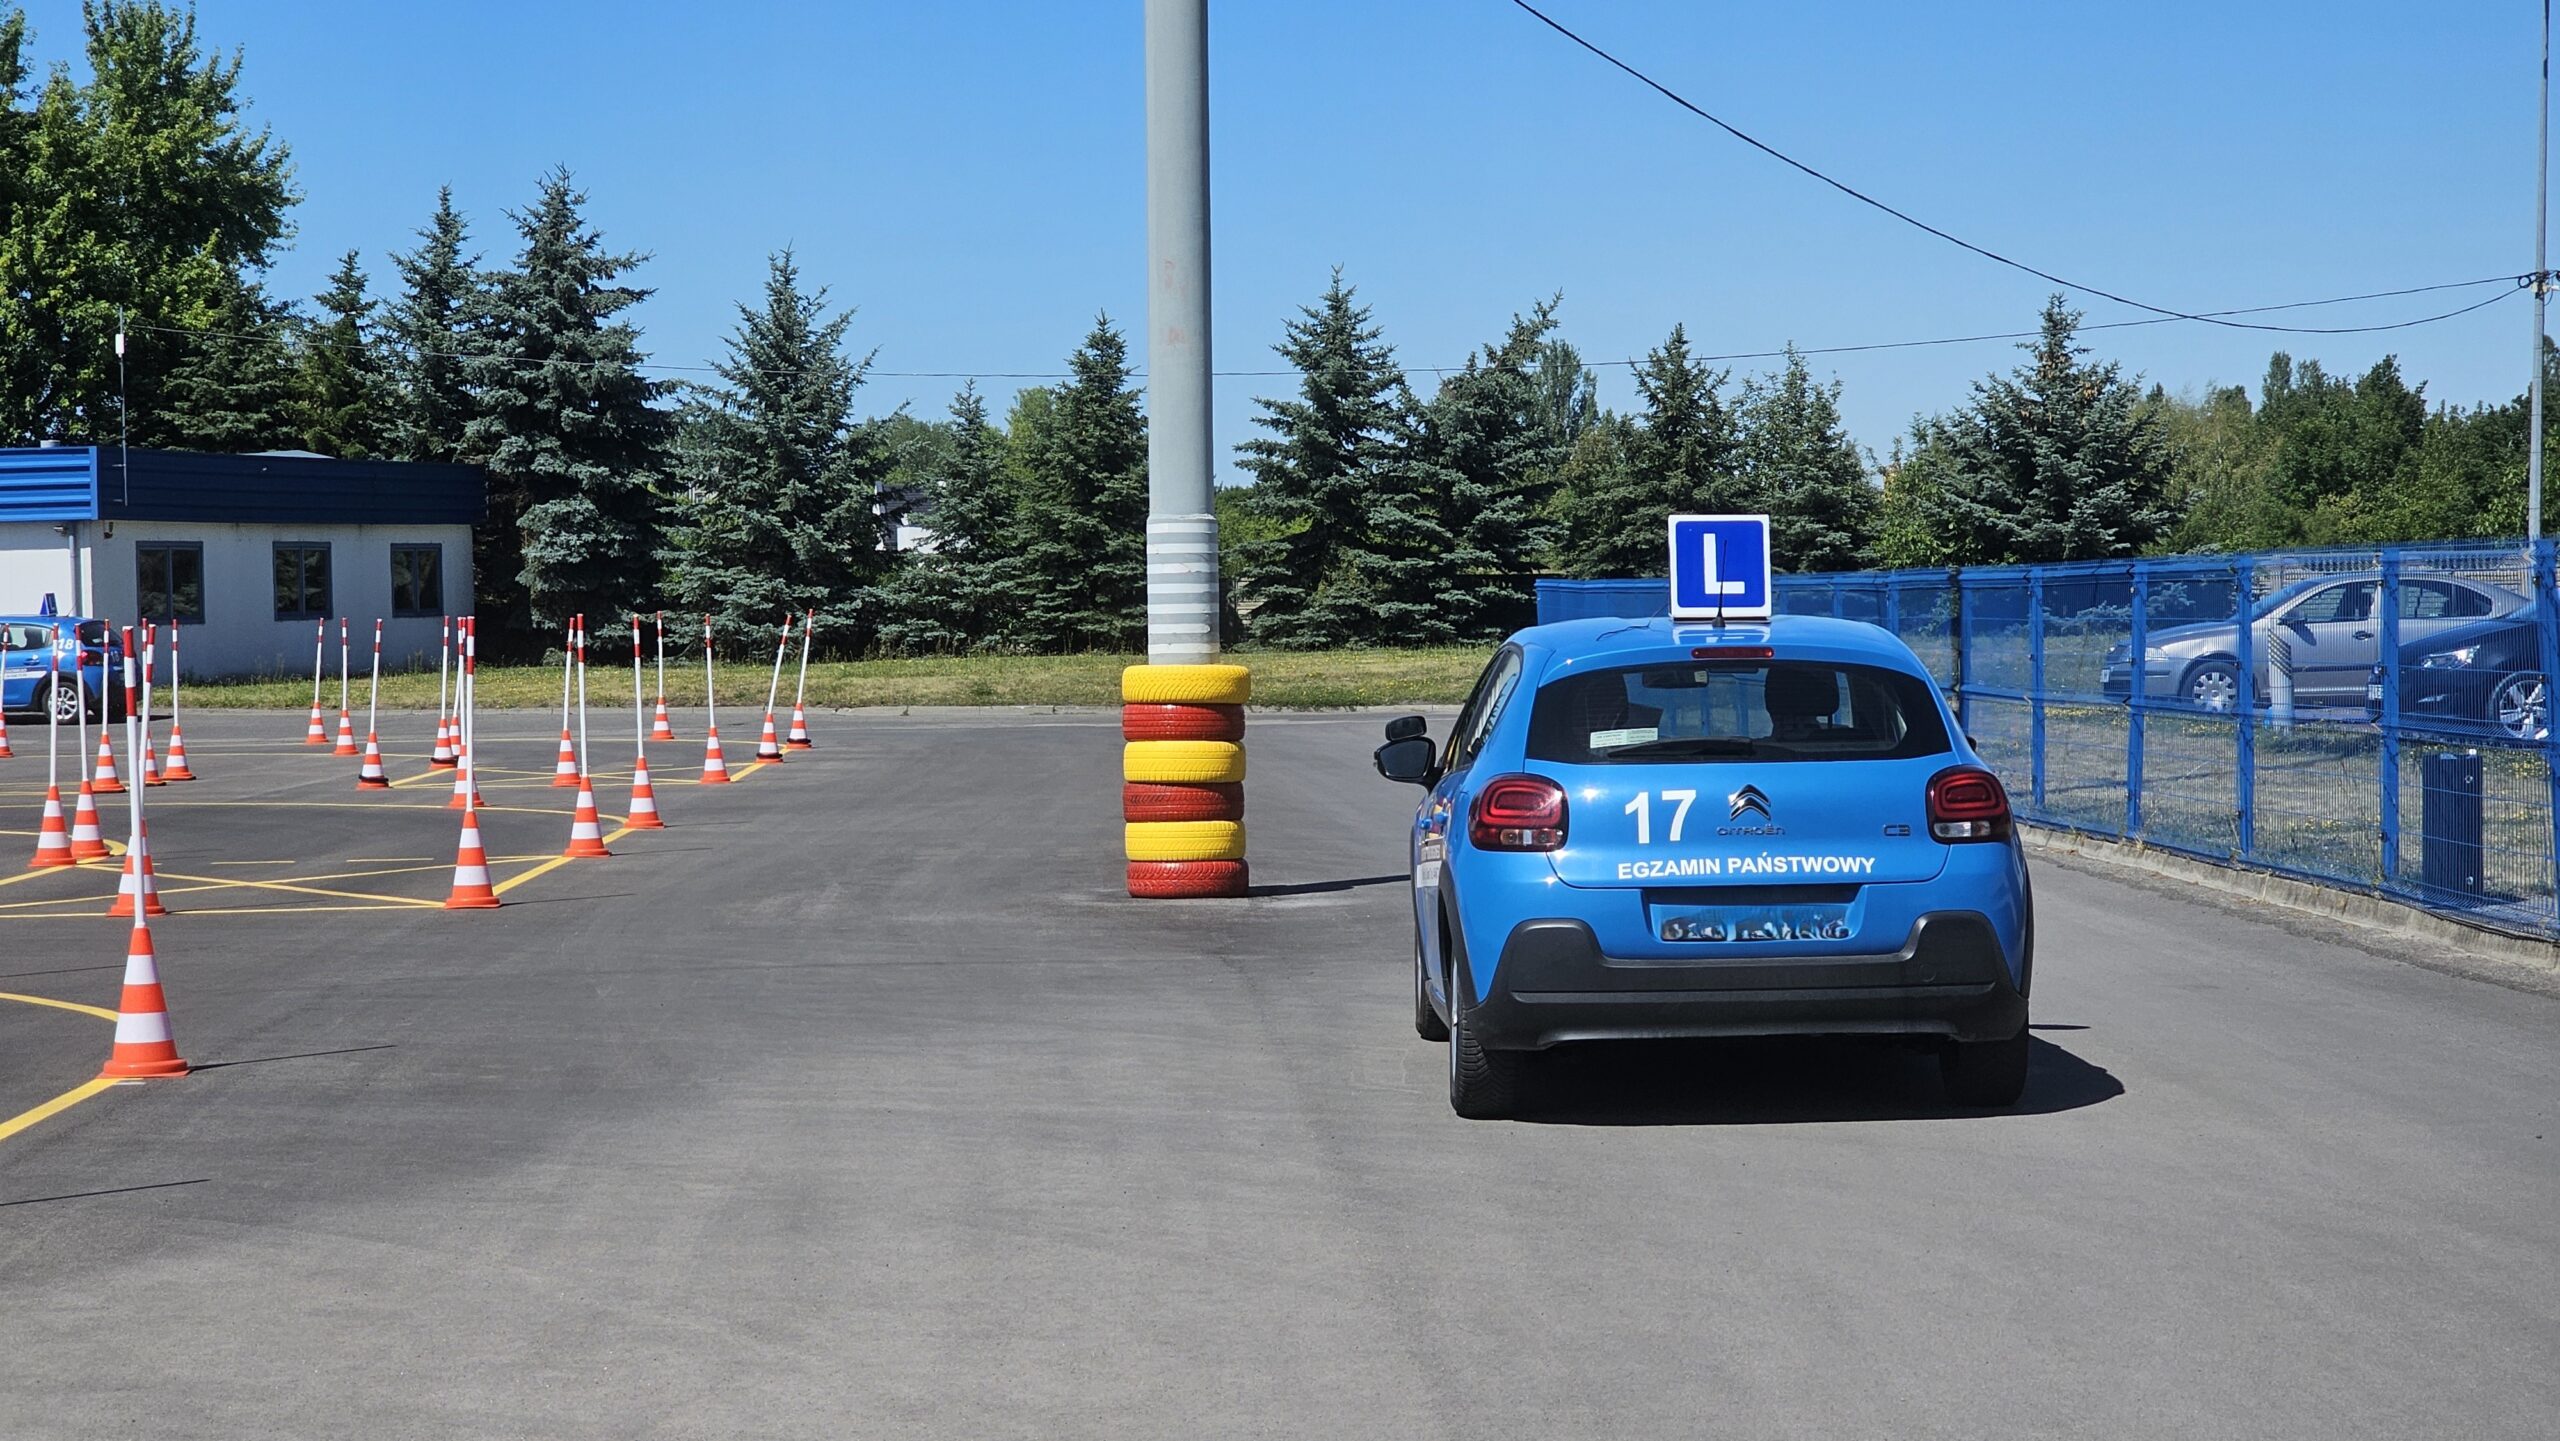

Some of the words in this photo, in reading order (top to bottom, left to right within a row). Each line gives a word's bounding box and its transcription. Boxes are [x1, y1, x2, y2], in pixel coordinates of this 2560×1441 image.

[1703, 533, 1745, 594] L
[58, 638, 74, 650] 18
[1625, 790, 1696, 843] 17
[1717, 823, 1786, 836] CITROËN
[1883, 825, 1911, 836] C3
[1618, 858, 1721, 879] EGZAMIN
[1728, 852, 1875, 874] PAŃSTWOWY
